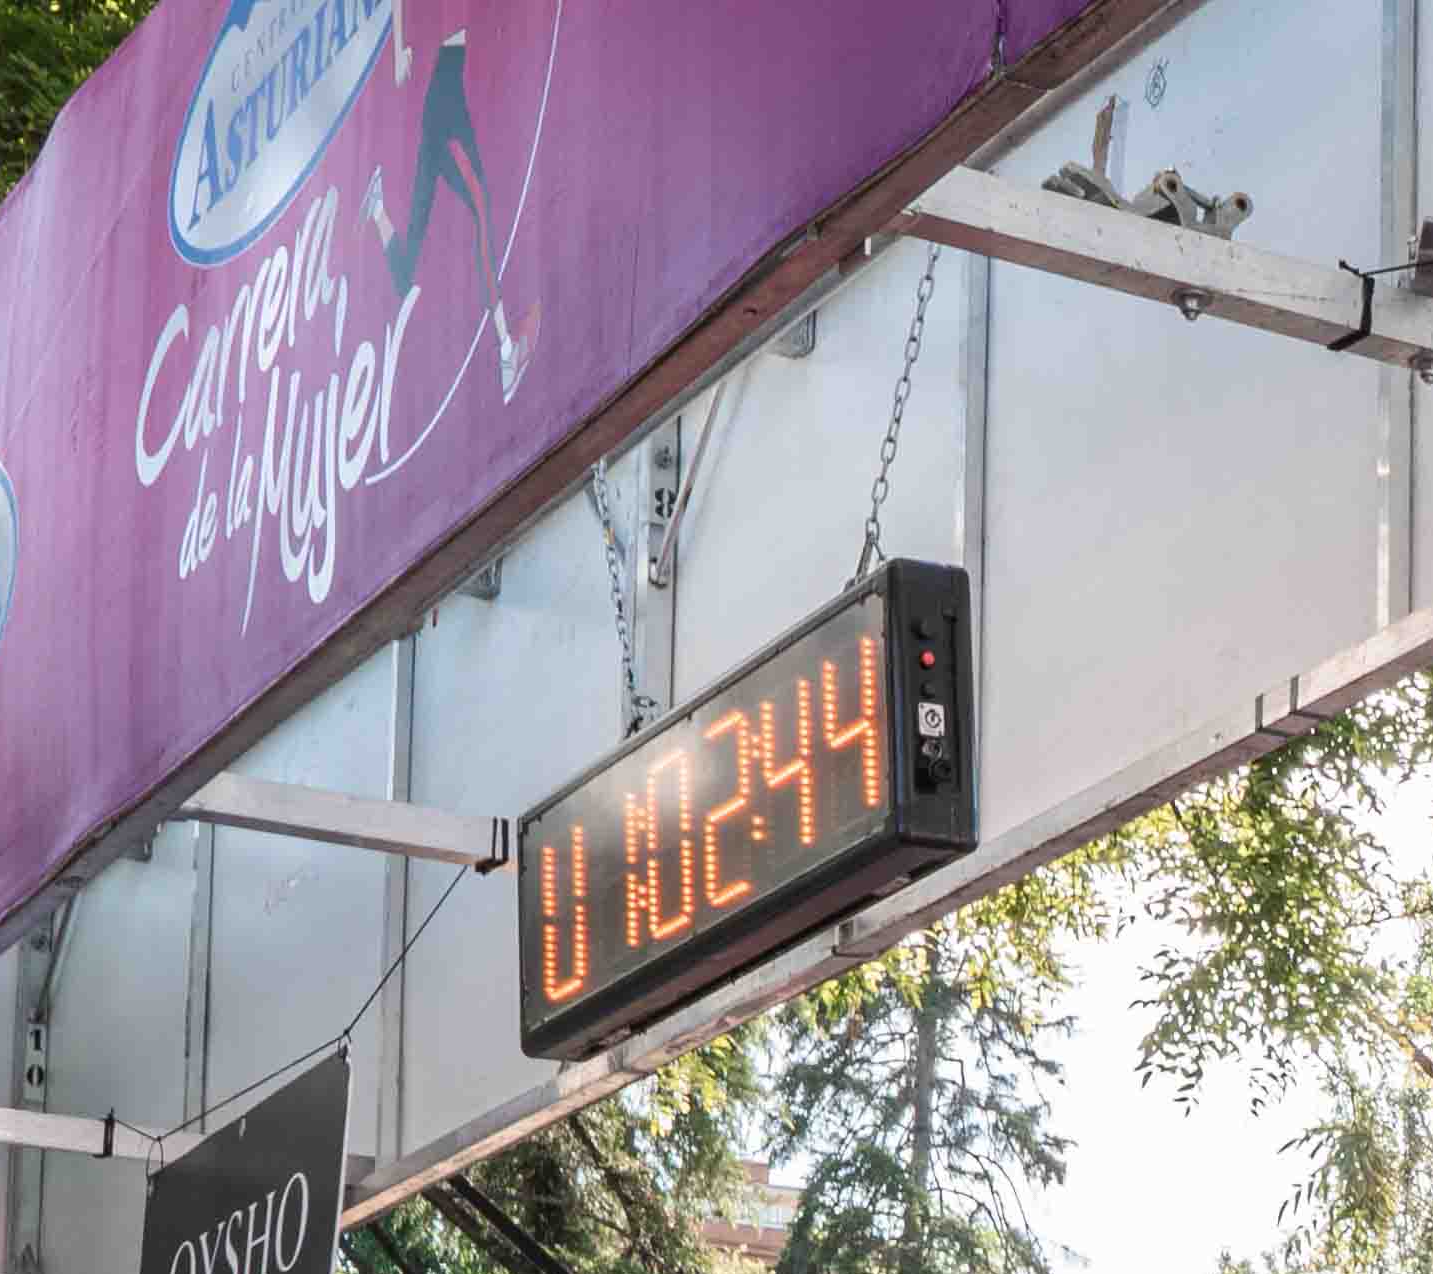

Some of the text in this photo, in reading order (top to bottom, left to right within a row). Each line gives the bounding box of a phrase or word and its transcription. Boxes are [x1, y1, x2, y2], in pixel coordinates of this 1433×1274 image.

[135, 184, 348, 486] Carrera
[179, 284, 422, 638] de la Mujer
